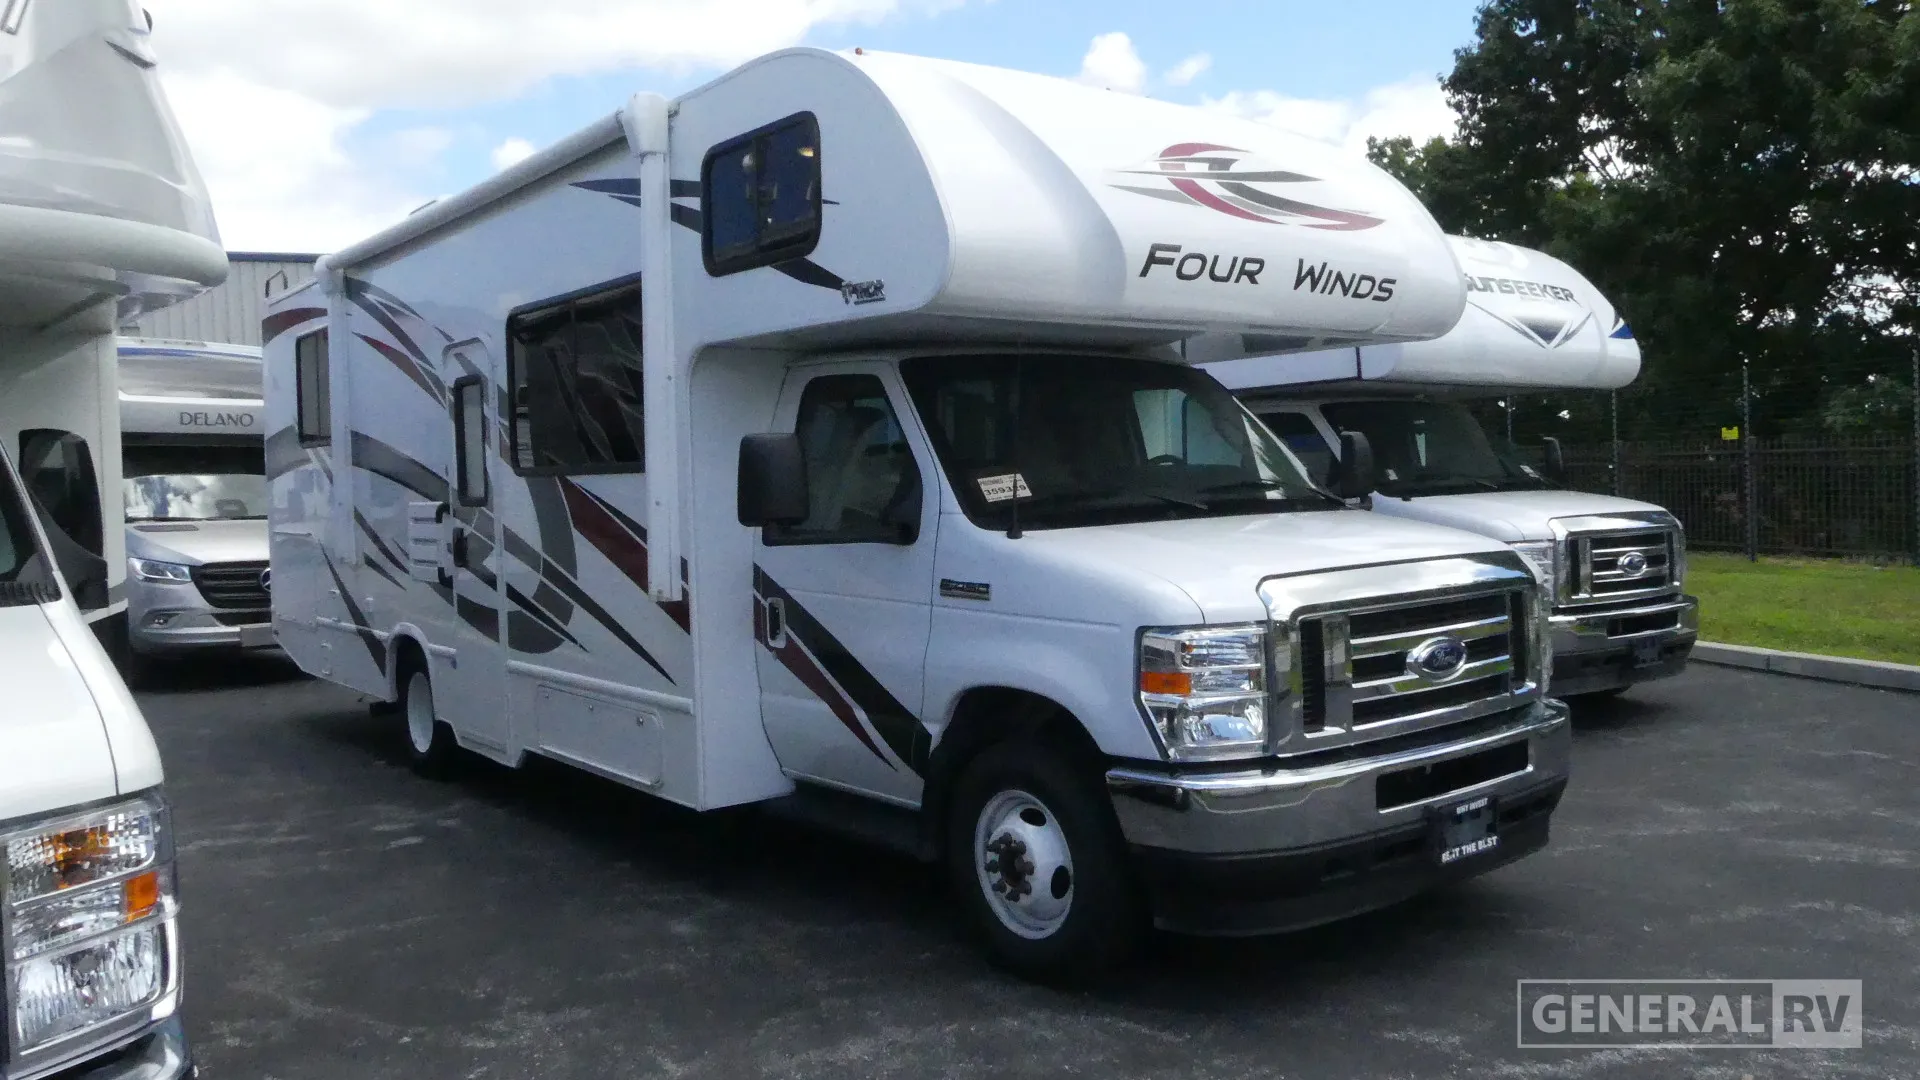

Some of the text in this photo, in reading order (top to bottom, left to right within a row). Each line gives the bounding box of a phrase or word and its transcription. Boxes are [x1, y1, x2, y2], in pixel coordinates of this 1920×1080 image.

[1138, 243, 1397, 302] FOUR WINDS
[180, 411, 253, 427] DELANO
[1461, 842, 1477, 856] THE
